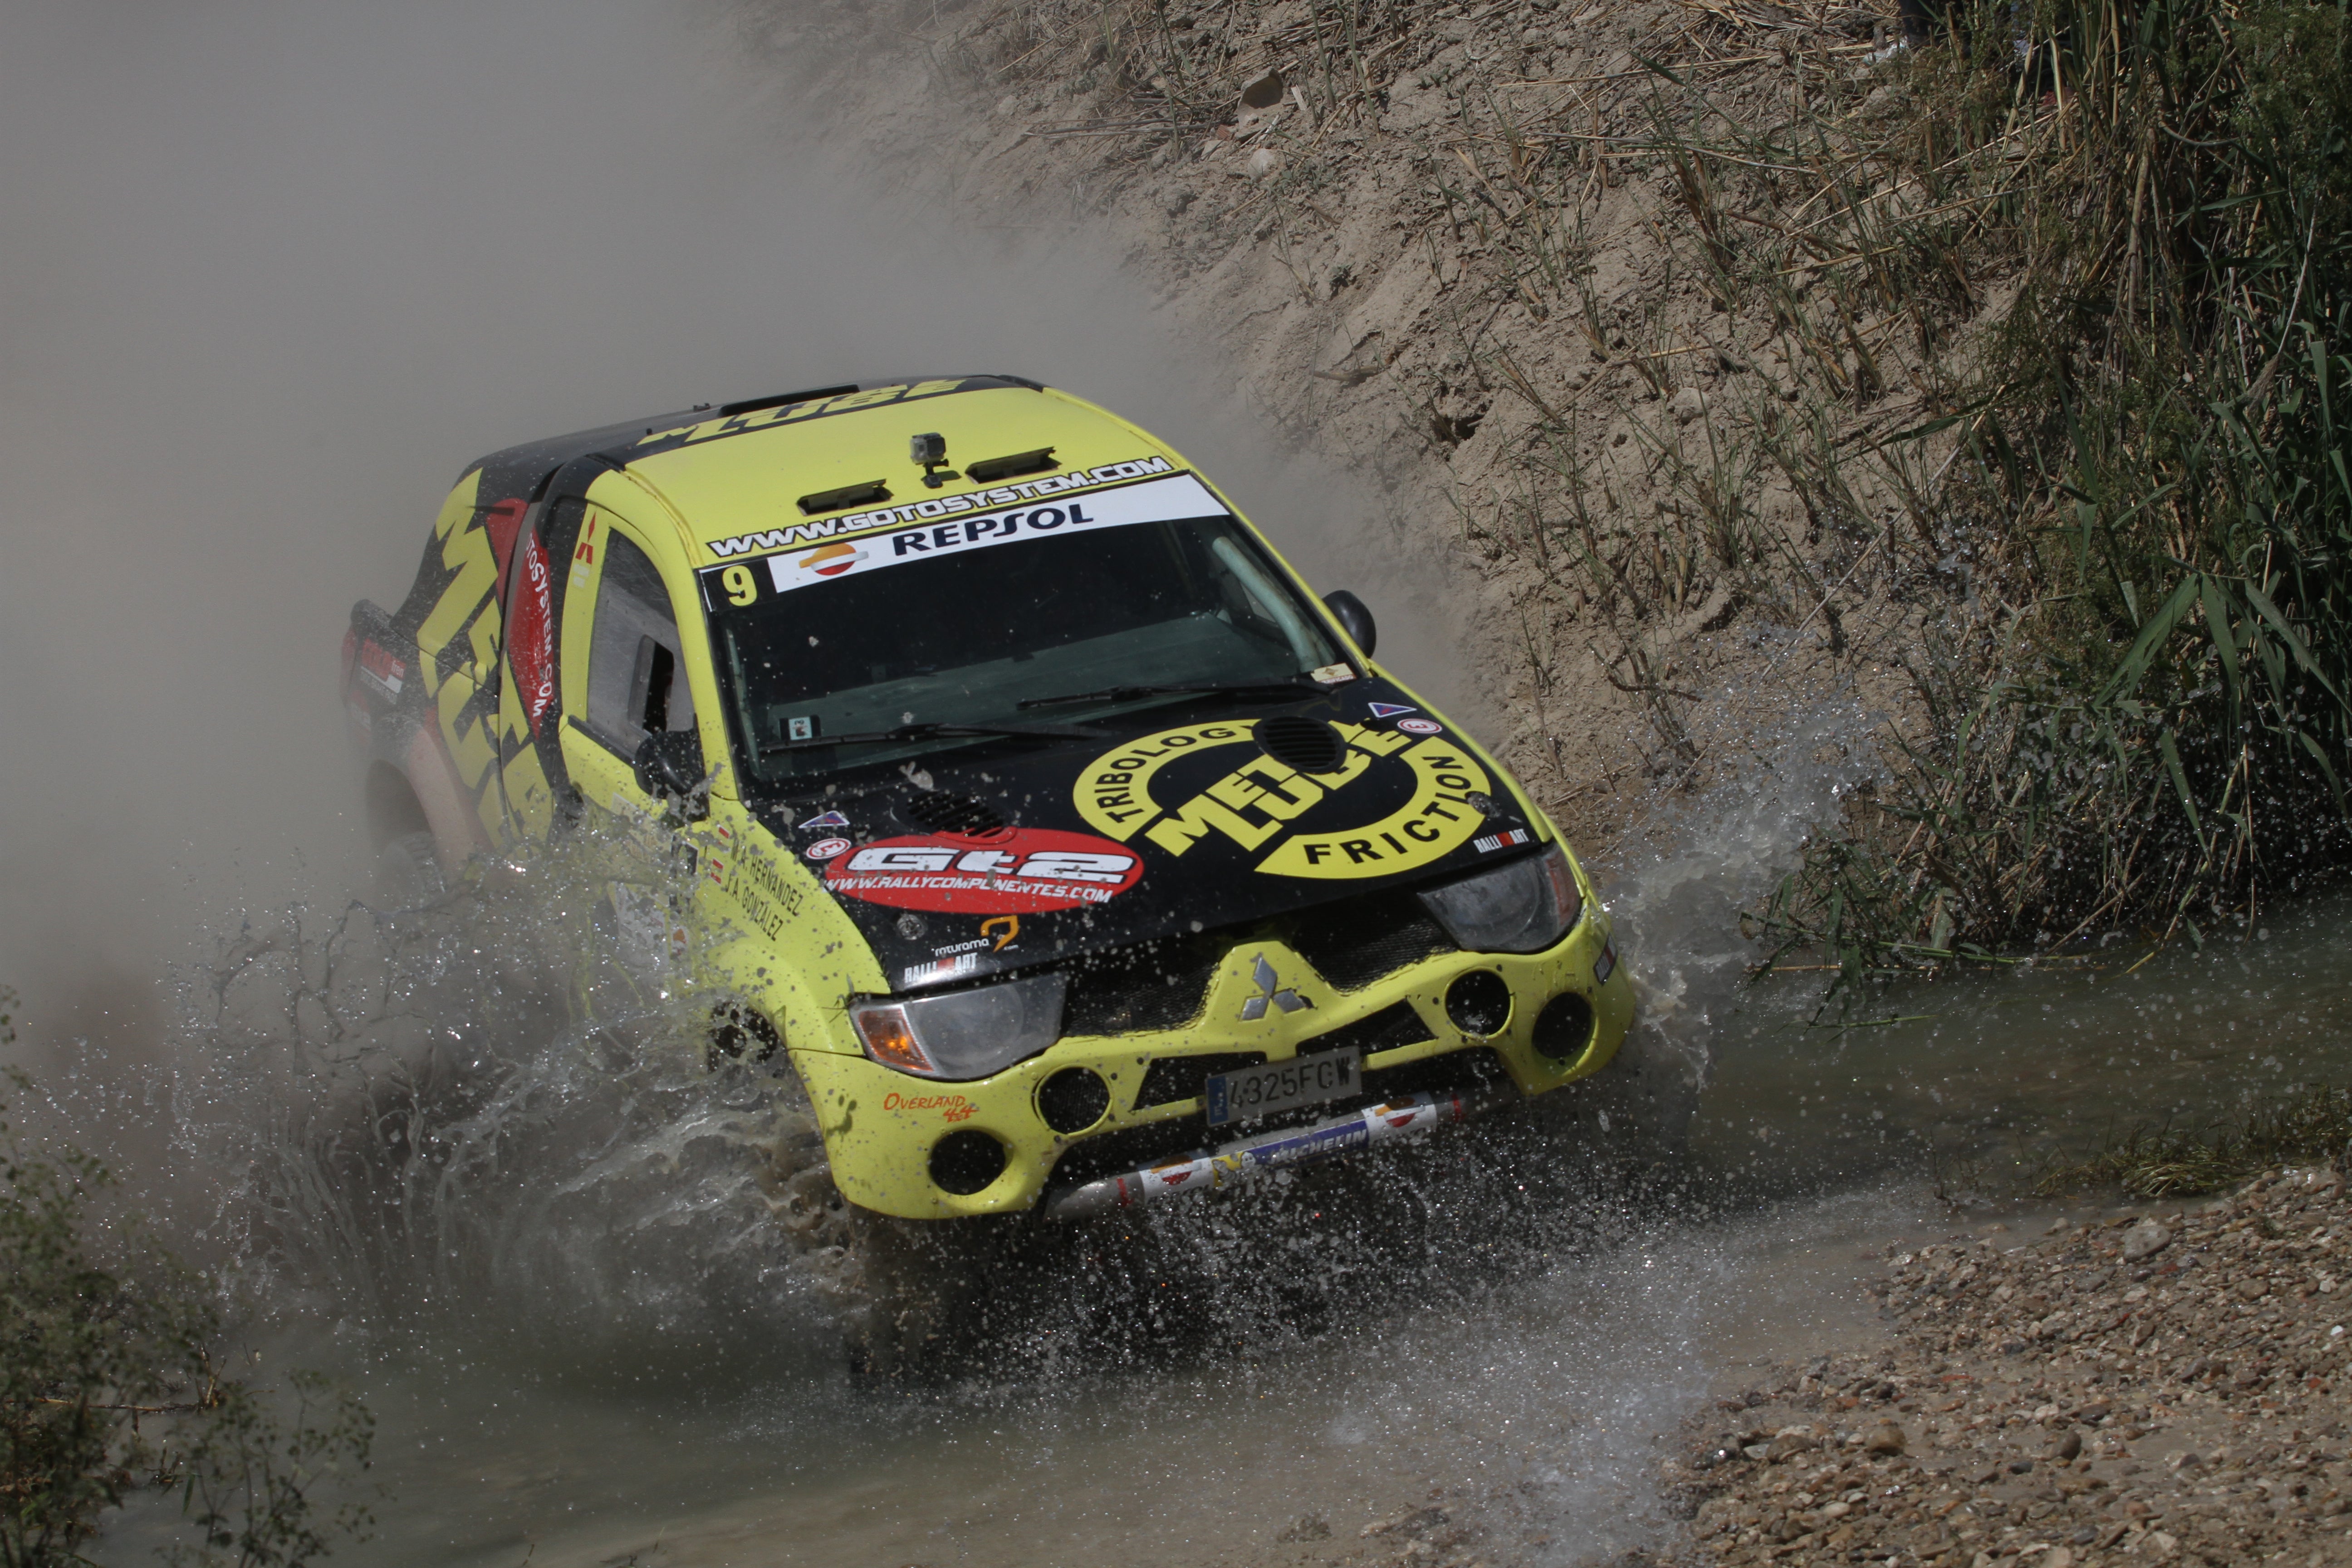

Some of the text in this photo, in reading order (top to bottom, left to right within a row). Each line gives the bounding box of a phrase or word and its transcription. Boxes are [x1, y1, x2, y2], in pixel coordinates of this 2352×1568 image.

[709, 455, 1173, 558] WWW.GOTOSYSTEM.COM
[892, 503, 1094, 556] REPSOL
[722, 565, 758, 607] 9
[1094, 726, 1253, 823] TRIBOLOG
[1303, 756, 1472, 864] FRICTION
[742, 886, 784, 941] GONZALEZ
[750, 854, 804, 916] HERNANDEZ
[935, 938, 990, 956] roturama
